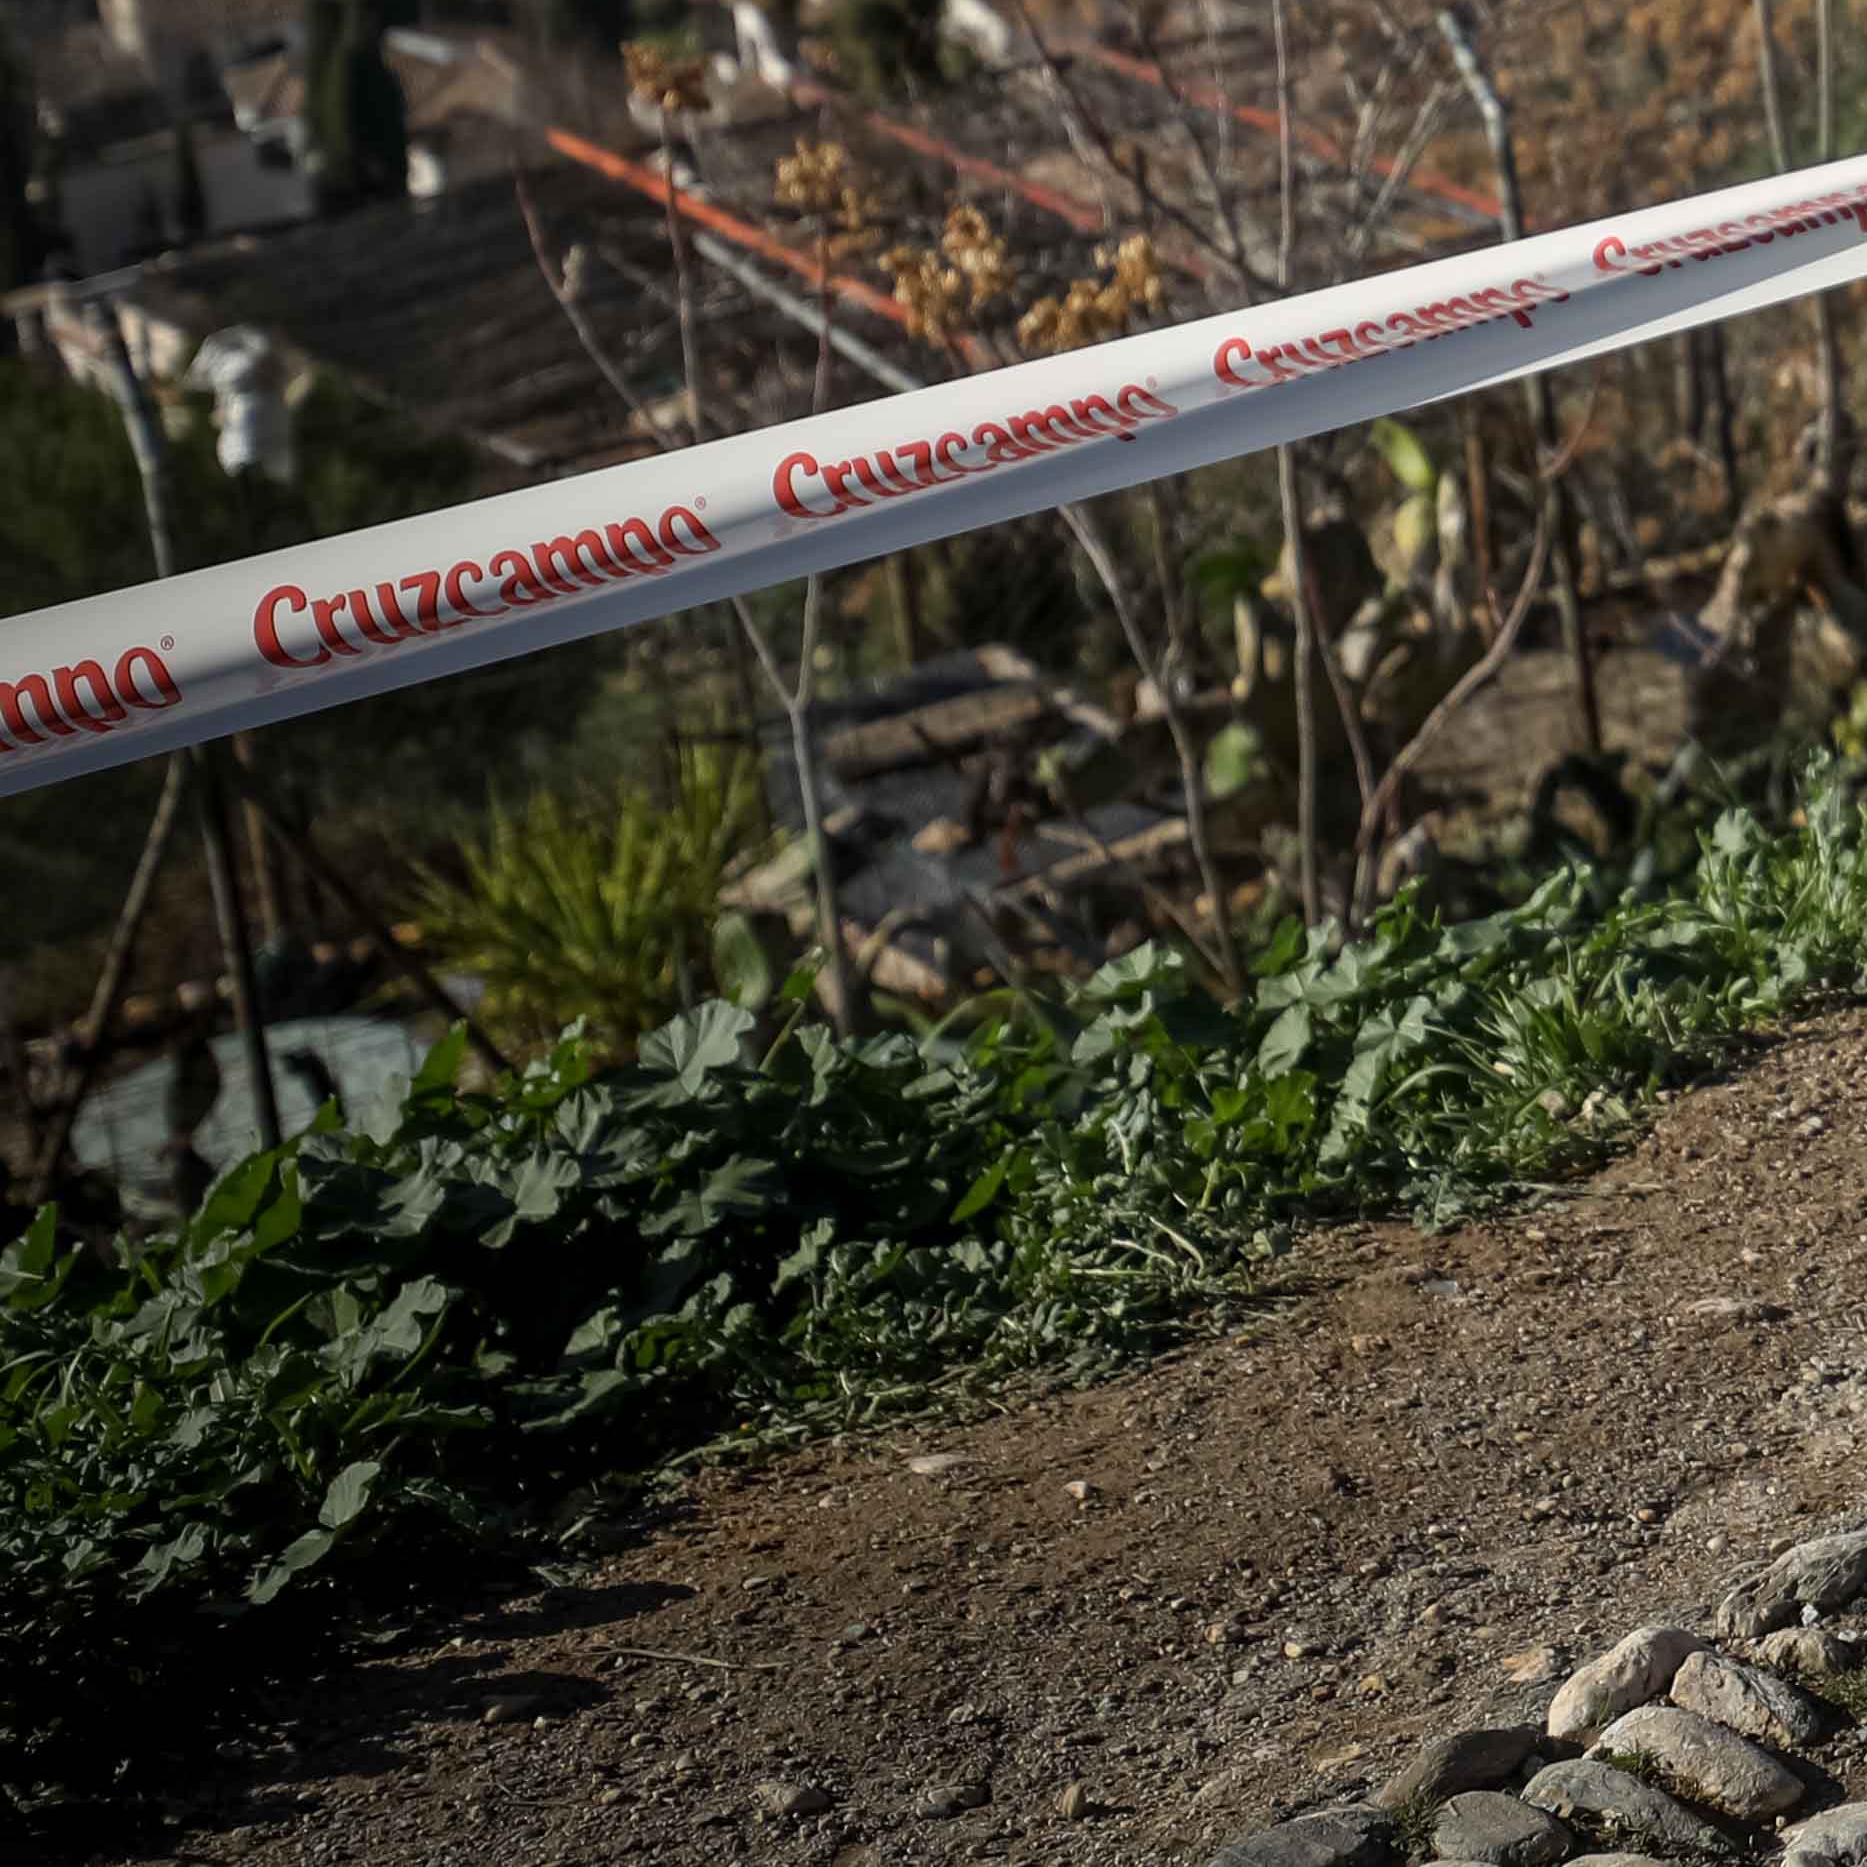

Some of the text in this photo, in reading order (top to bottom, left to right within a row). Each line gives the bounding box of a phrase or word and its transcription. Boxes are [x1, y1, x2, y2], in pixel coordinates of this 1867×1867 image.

[1213, 277, 1570, 389] Cruzcampo
[772, 383, 1179, 519] Cruzcampo
[252, 504, 723, 669] Cruzcampo
